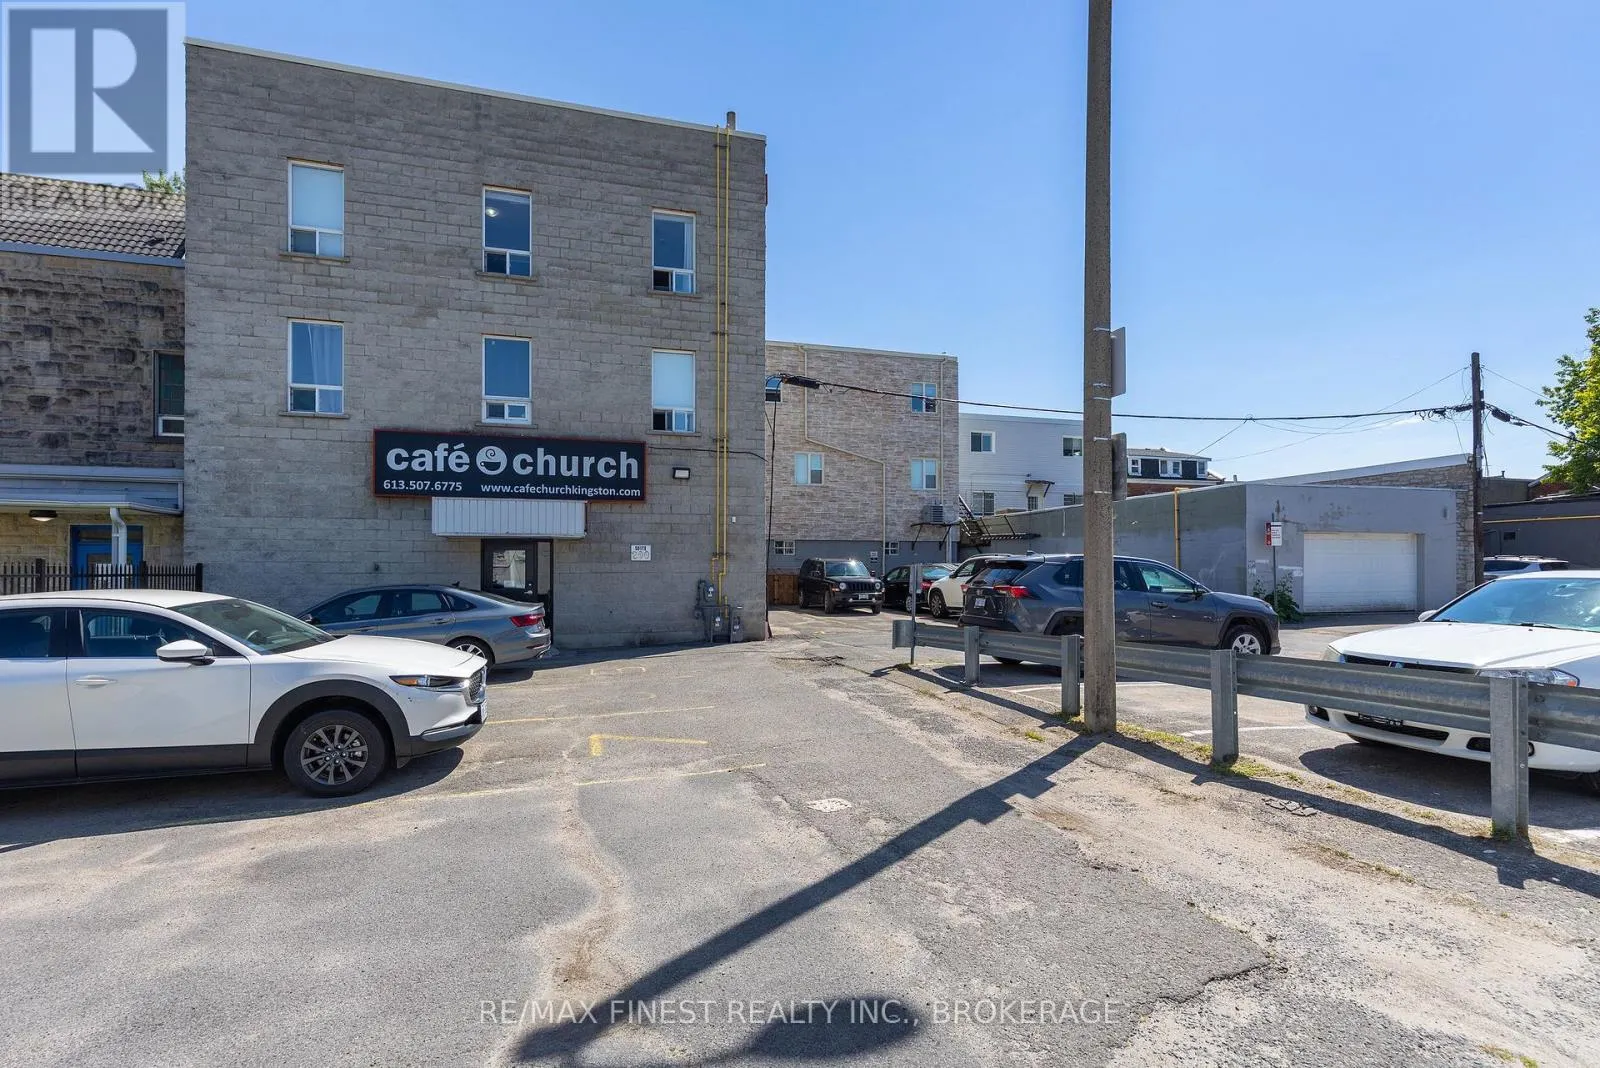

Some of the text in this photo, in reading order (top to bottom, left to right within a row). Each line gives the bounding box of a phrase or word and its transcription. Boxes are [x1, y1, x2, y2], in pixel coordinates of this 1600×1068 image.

[386, 442, 639, 479] café church
[383, 479, 641, 497] 613.507.6775 www.cafechurchkingston.com
